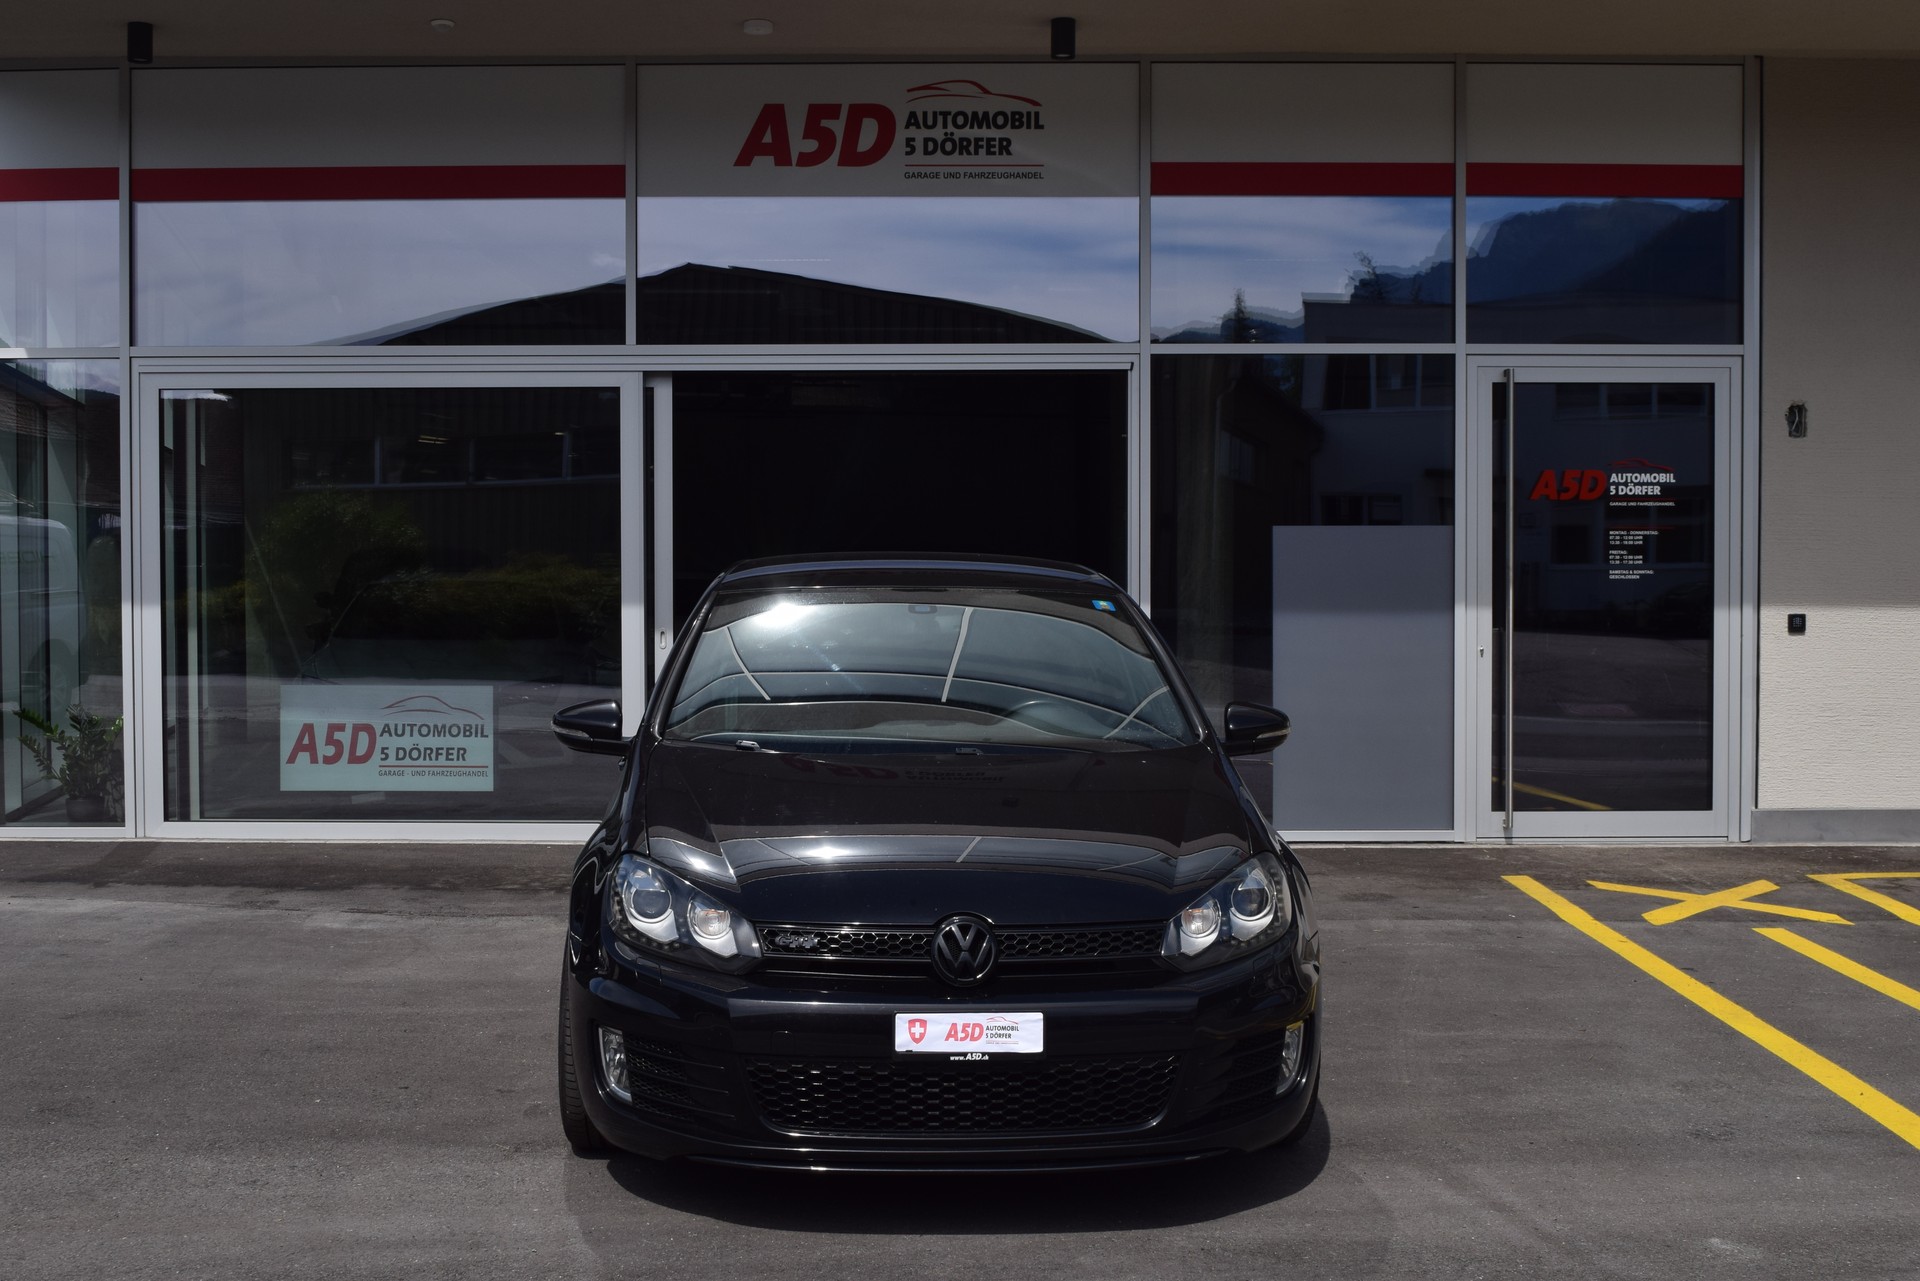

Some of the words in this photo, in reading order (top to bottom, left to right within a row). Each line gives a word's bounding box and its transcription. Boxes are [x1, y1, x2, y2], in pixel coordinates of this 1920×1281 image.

[904, 110, 1045, 130] AUTOMOBIL
[733, 103, 896, 167] A5D
[905, 137, 917, 156] 5
[923, 132, 1013, 156] DÖRFER
[904, 171, 941, 180] GARAGE
[943, 171, 961, 180] UND
[963, 171, 1045, 180] FAHRZEUGHANDEL
[1530, 469, 1607, 501] A5D
[1609, 473, 1676, 483] AUTOMOBIL
[1609, 485, 1617, 495] 5
[1618, 483, 1661, 495] DÖRFER
[379, 723, 489, 738] AUTOMOBIL
[286, 722, 377, 765] A5D
[380, 747, 390, 761] 5
[395, 744, 467, 762] DÖRFER
[379, 769, 405, 777] GARAGE
[411, 769, 426, 777] UND
[428, 769, 489, 778] FAHRZEUGHANDEL
[945, 1023, 984, 1042] A5D
